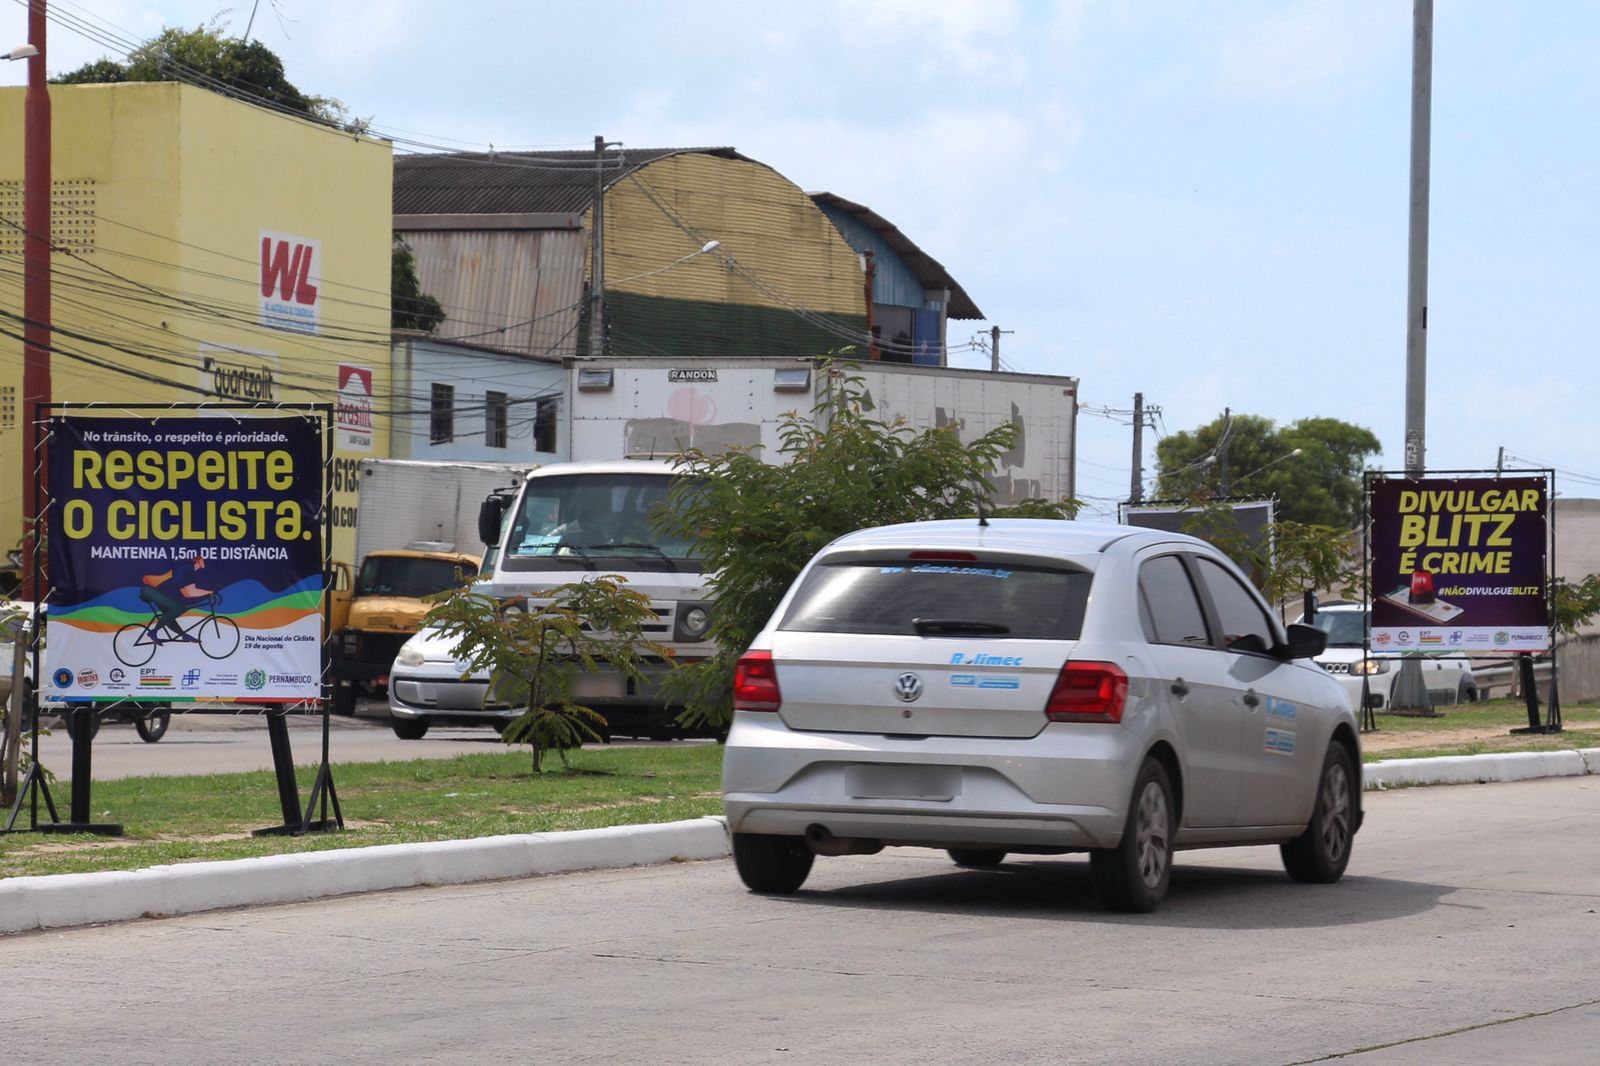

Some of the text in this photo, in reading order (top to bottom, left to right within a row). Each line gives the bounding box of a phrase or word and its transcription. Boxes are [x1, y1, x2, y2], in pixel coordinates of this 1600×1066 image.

[262, 237, 317, 305] WL
[214, 365, 273, 399] quartzolit
[671, 370, 716, 379] RANDON
[83, 431, 289, 445] No trânsito, o respeito é prioridade.
[1398, 489, 1540, 513] DIVULGAR
[63, 499, 93, 539] O
[1399, 514, 1516, 547] BLITZ
[90, 543, 289, 562] MANTENHA 1,5m DE DISTÂNCIA
[1399, 546, 1513, 575] É CRIME
[1438, 585, 1539, 596] #NÃODIVULGUEBLITZ
[262, 643, 284, 651] agosto
[140, 668, 157, 676] EPT
[268, 675, 312, 684] PERNAMBUCO
